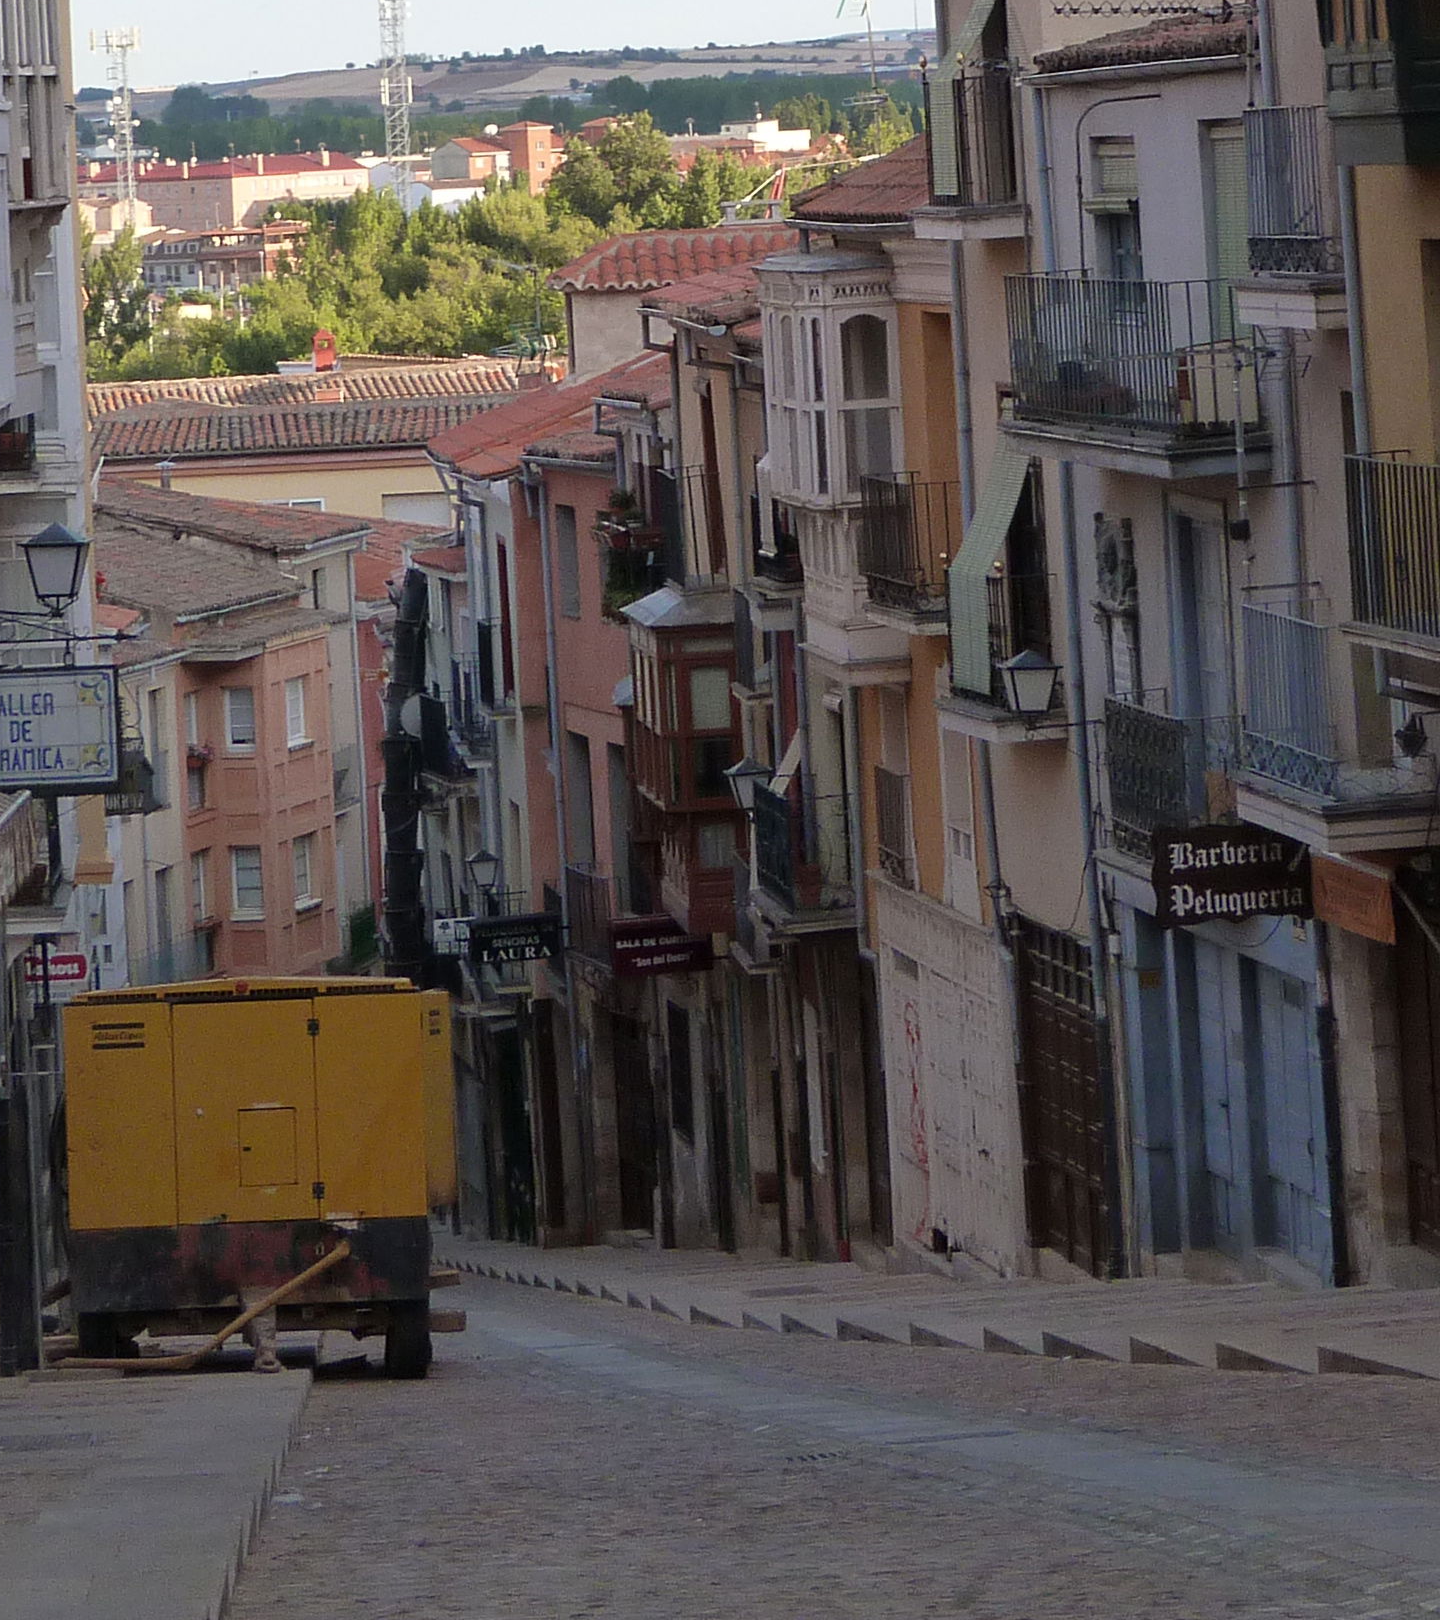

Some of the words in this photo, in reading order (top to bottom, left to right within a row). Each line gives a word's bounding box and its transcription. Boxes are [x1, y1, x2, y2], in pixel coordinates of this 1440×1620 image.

[9, 720, 33, 743] DE
[615, 939, 641, 949] SALA
[481, 945, 552, 962] LAURA
